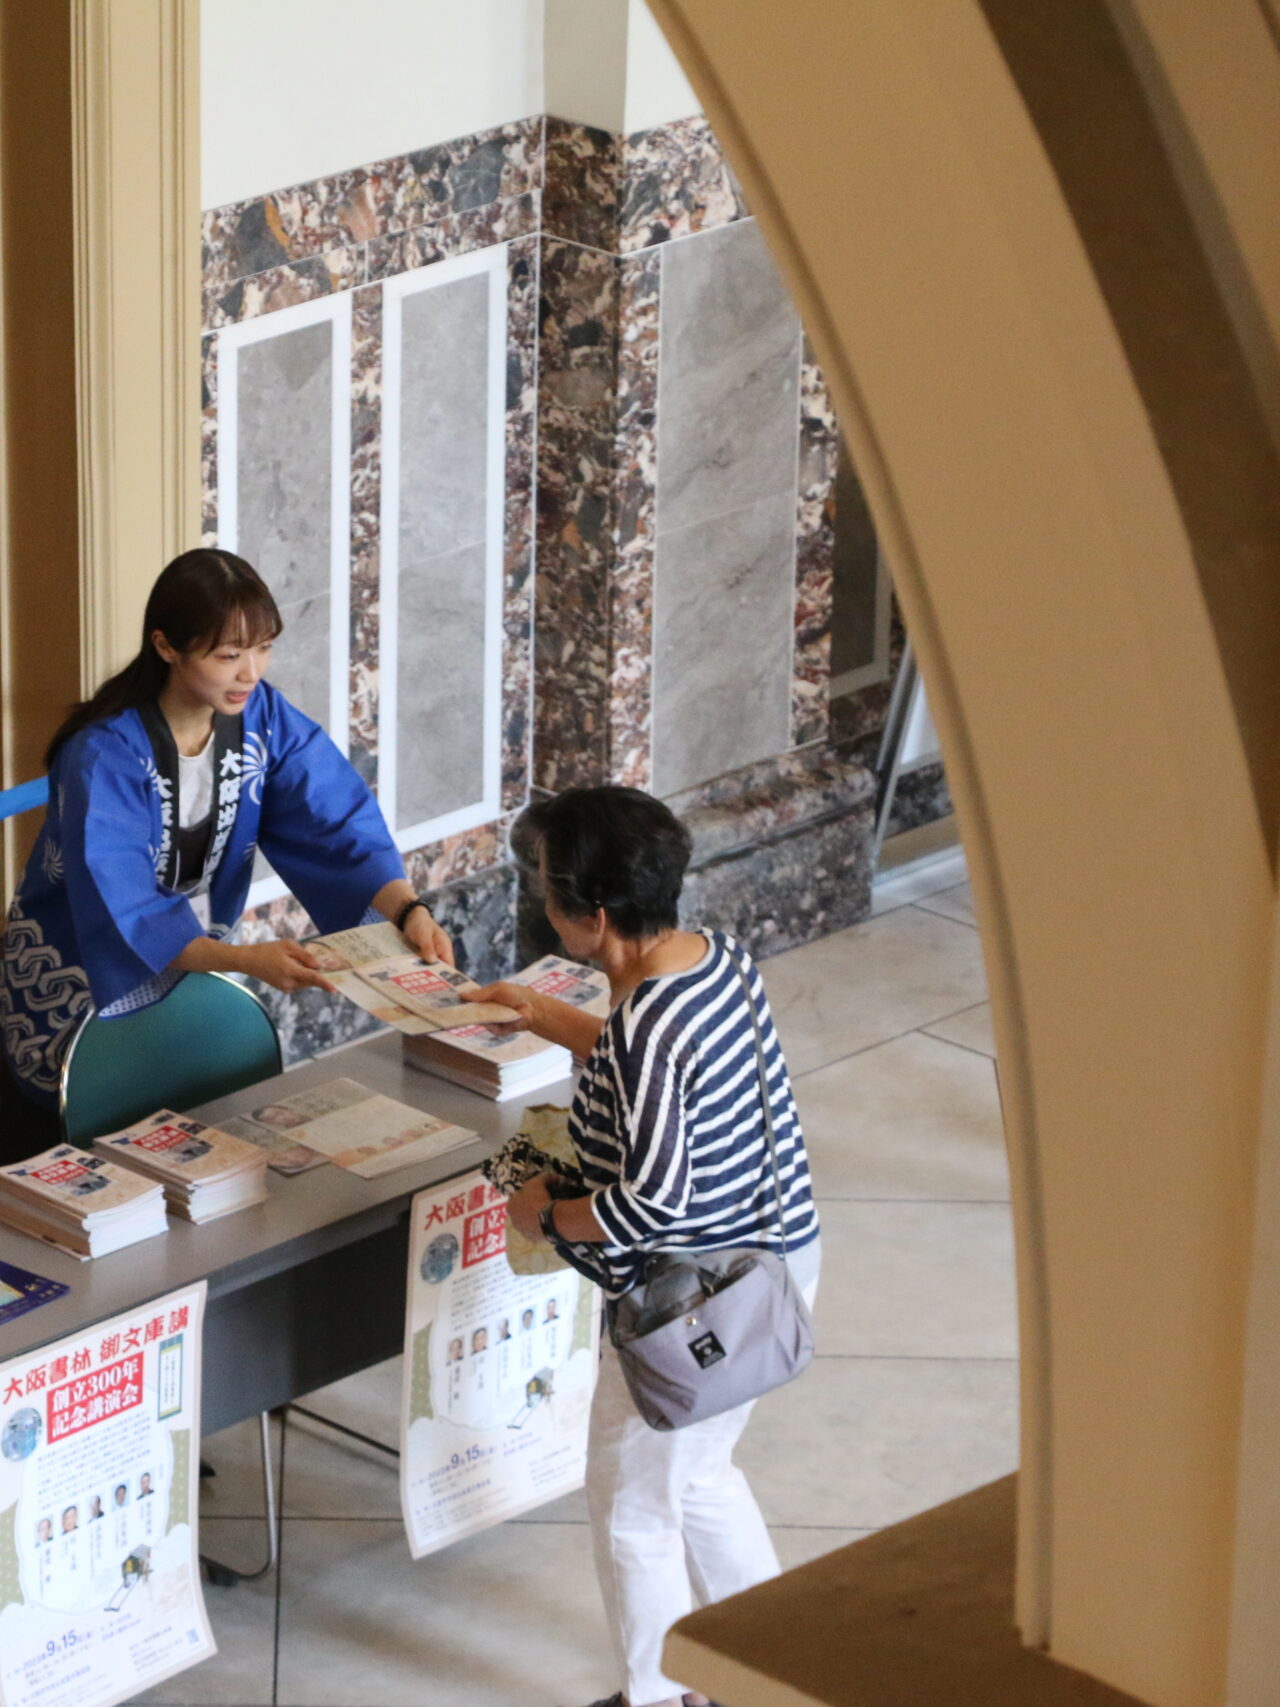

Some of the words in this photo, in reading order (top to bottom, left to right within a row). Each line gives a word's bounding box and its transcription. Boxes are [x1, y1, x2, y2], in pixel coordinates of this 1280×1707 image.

[206, 749, 242, 886] 大阪出版
[3, 1347, 91, 1405] 大阪書林
[100, 1305, 190, 1363] 御文庫講
[52, 1358, 139, 1413] 創立300年
[52, 1383, 139, 1439] 記念講演会
